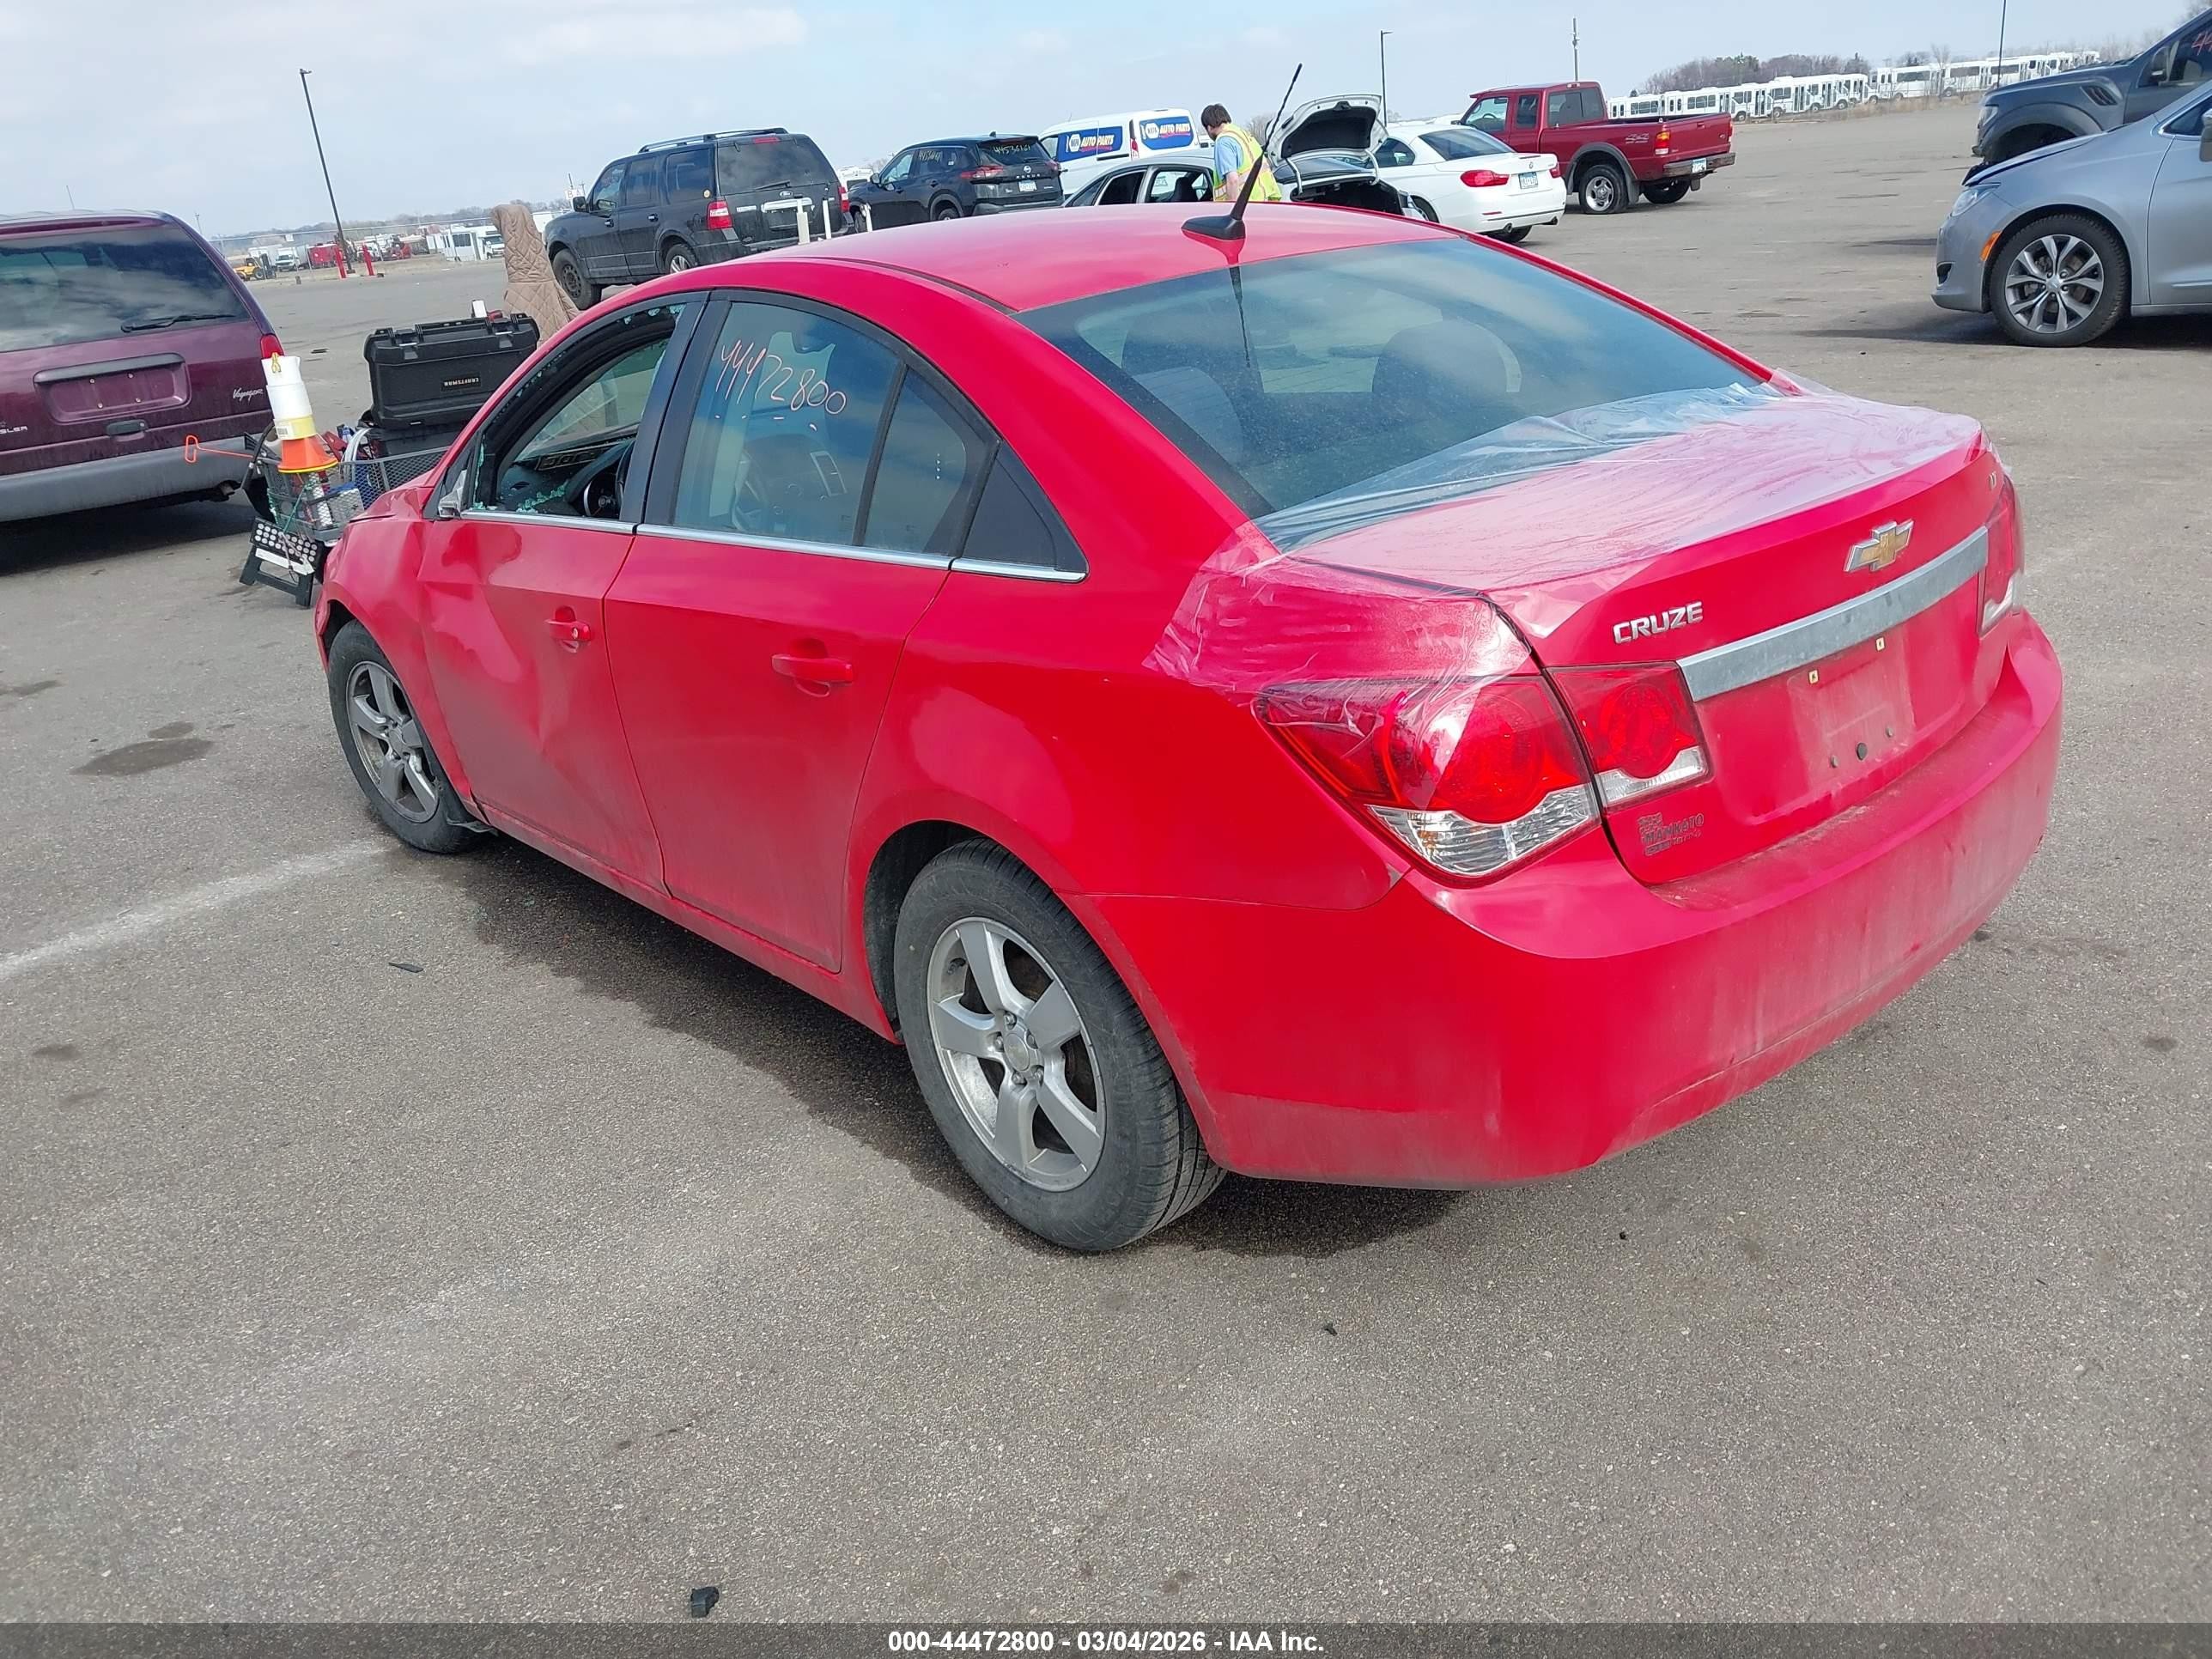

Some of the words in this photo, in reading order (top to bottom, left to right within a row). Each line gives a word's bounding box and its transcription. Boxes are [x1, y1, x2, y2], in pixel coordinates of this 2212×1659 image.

[1160, 124, 1175, 134] AUTO
[1081, 137, 1097, 147] AUTO
[1097, 135, 1115, 146] PARTS
[444, 378, 479, 386] CRAFTSMAN
[715, 340, 847, 414] 44472800
[1613, 601, 1704, 644] CRUZE
[1644, 812, 1705, 843] MANKATO
